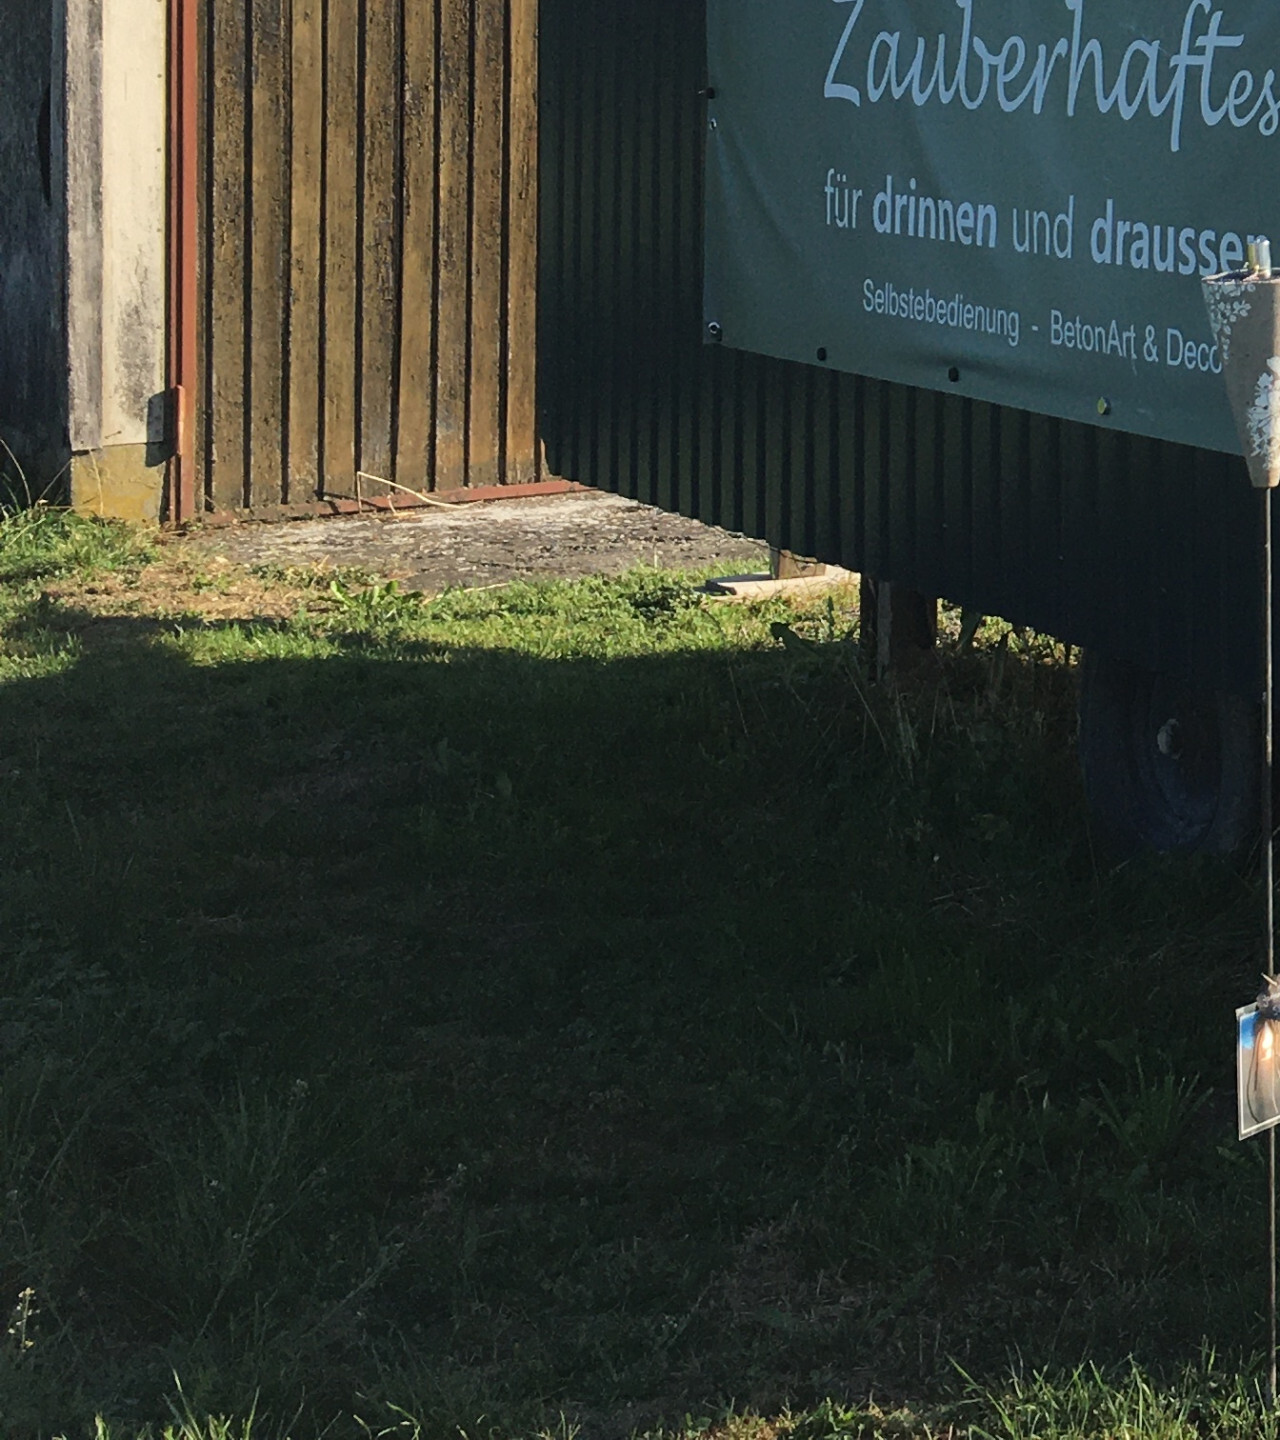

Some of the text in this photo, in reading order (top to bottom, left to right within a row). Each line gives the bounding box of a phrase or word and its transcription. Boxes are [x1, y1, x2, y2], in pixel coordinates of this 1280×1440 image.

[824, 168, 1268, 277] für drinnen und drausse
[862, 278, 1020, 347] Selbstebedienung
[1050, 309, 1137, 359] BetonArt
[1143, 324, 1159, 362] &
